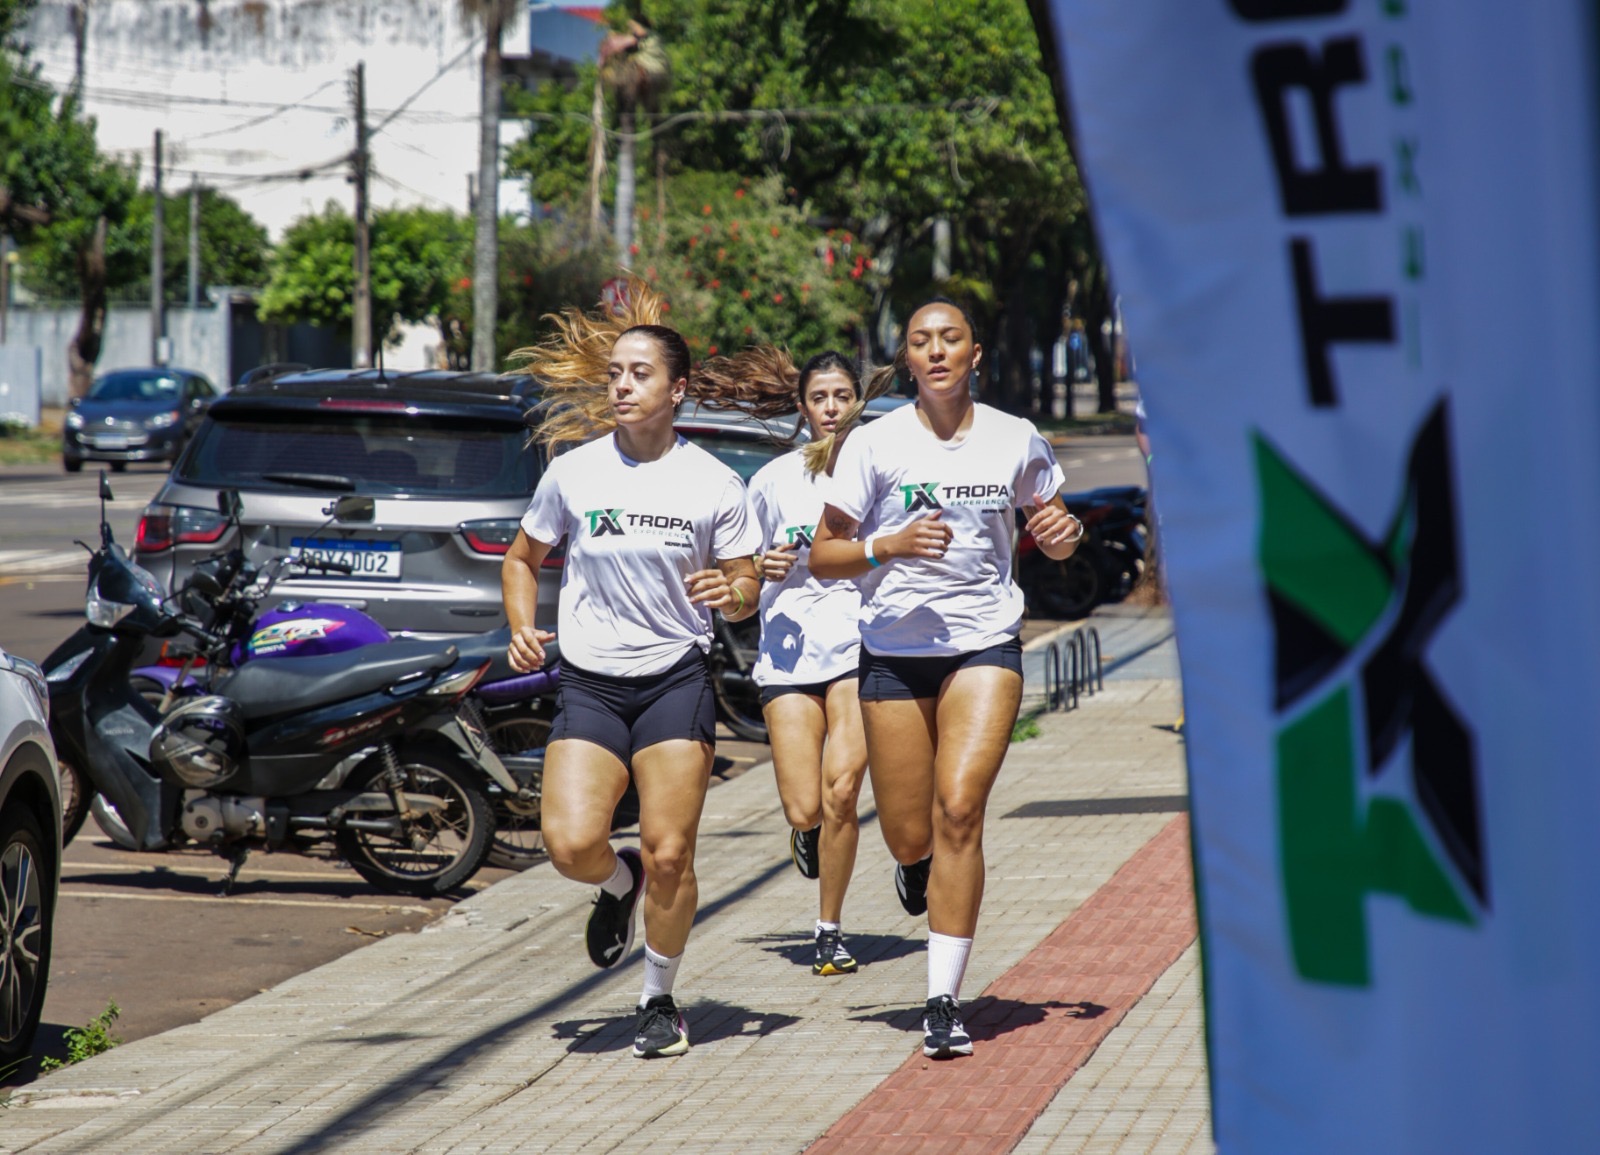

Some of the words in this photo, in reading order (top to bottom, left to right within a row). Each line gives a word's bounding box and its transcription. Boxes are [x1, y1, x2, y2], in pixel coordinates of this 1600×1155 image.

[1379, 0, 1424, 283] EXP
[1223, 0, 1397, 411] TR
[942, 484, 1009, 499] TROPA
[950, 499, 1007, 507] EXPERIENCE
[626, 513, 695, 534] TROPA
[633, 528, 691, 540] EXPERIENCE
[254, 644, 286, 655] HONDA
